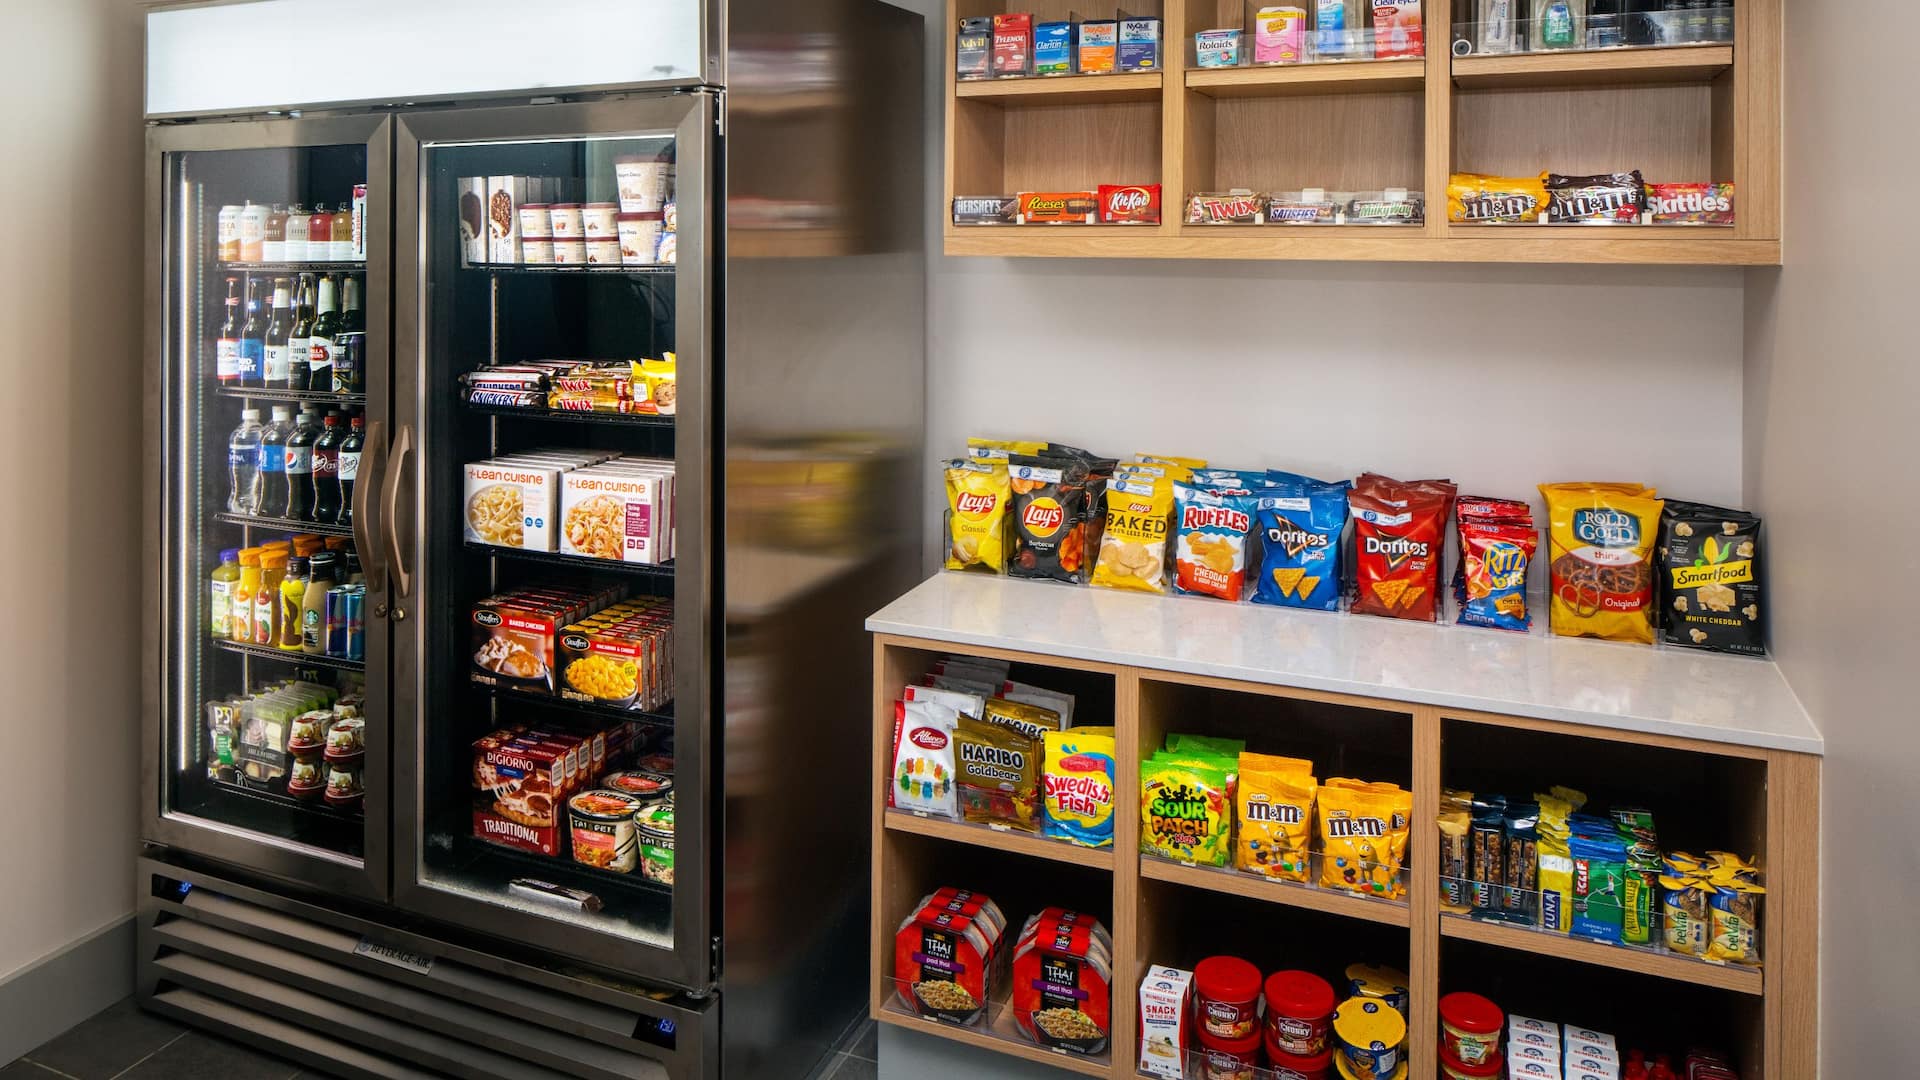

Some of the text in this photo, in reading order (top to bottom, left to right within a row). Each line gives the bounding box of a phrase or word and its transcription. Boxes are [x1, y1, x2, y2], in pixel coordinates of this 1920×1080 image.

[1126, 21, 1149, 31] NyQuil
[961, 37, 985, 49] Advil
[995, 35, 1025, 45] TYLENOL
[1036, 40, 1063, 51] Claritin
[1199, 39, 1233, 50] Rolaids
[957, 200, 1001, 214] HERSHEY'S
[1270, 207, 1317, 220] SATISFIES
[958, 491, 996, 513] Lay's
[1025, 504, 1064, 527] Lay's
[1107, 513, 1167, 534] BAKED
[1184, 506, 1250, 532] RUFFLES
[1584, 511, 1631, 526] ROLD
[961, 524, 987, 533] Classic
[1269, 528, 1329, 546] Doritos
[1579, 524, 1634, 543] GOLD
[1366, 536, 1428, 557] Doritos
[1485, 547, 1528, 574] RITZ
[1194, 567, 1229, 584] CHEDDAR
[1677, 565, 1747, 585] Smartfood
[1604, 597, 1640, 610] Original
[1685, 615, 1742, 626] WHITE CHEDDAR
[962, 743, 1024, 770] HARIBO
[966, 764, 1022, 782] Goldbears
[1045, 773, 1111, 803] Swedish
[1057, 793, 1098, 817] Fish
[1152, 798, 1206, 820] SOUR
[483, 819, 540, 846] TRADITIONAL
[1151, 815, 1209, 837] PATCH
[1545, 894, 1556, 929] LUNA
[925, 938, 952, 955] THAI
[1045, 965, 1074, 981] THAI
[1047, 984, 1060, 992] pad
[1145, 1004, 1176, 1016] SNACK
[1207, 1005, 1237, 1020] CHUNKY
[1280, 1022, 1310, 1037] CHUNKY
